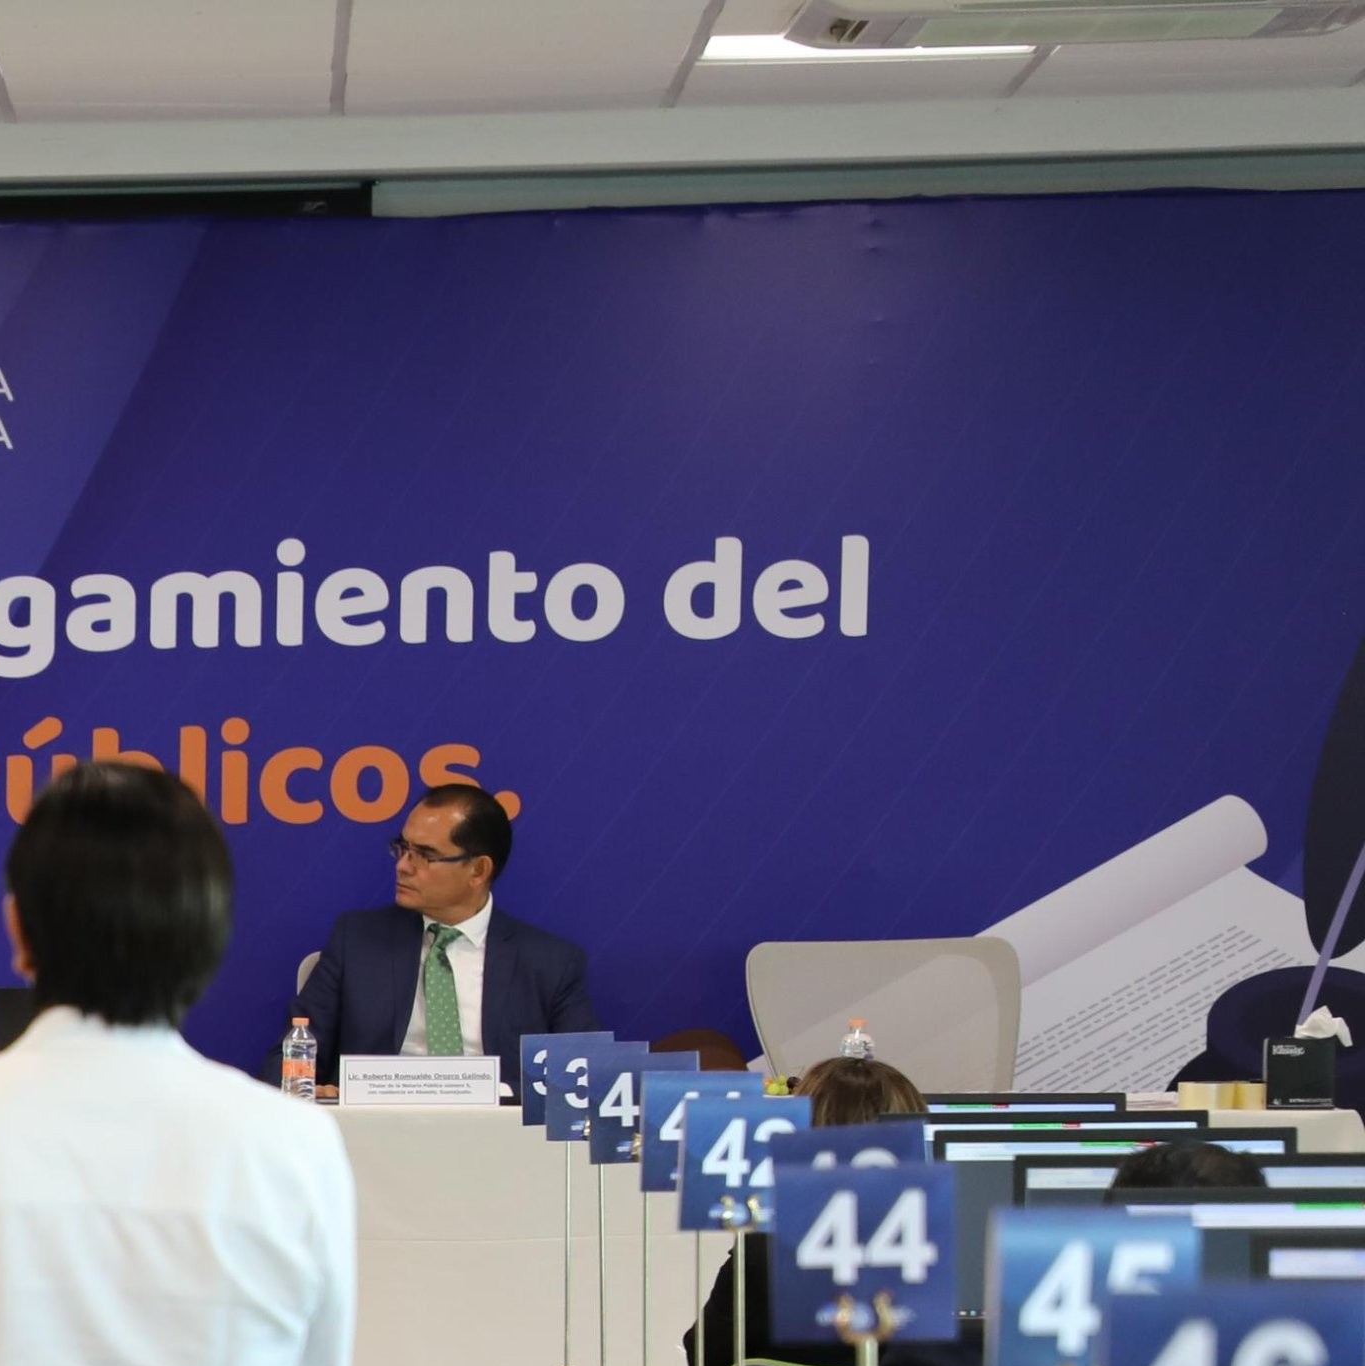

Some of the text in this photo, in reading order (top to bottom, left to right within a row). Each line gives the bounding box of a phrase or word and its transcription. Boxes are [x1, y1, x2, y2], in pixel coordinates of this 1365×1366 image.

[662, 534, 871, 640] del
[565, 1057, 589, 1109] 3
[599, 1072, 640, 1127] 4
[795, 1187, 939, 1285] 44
